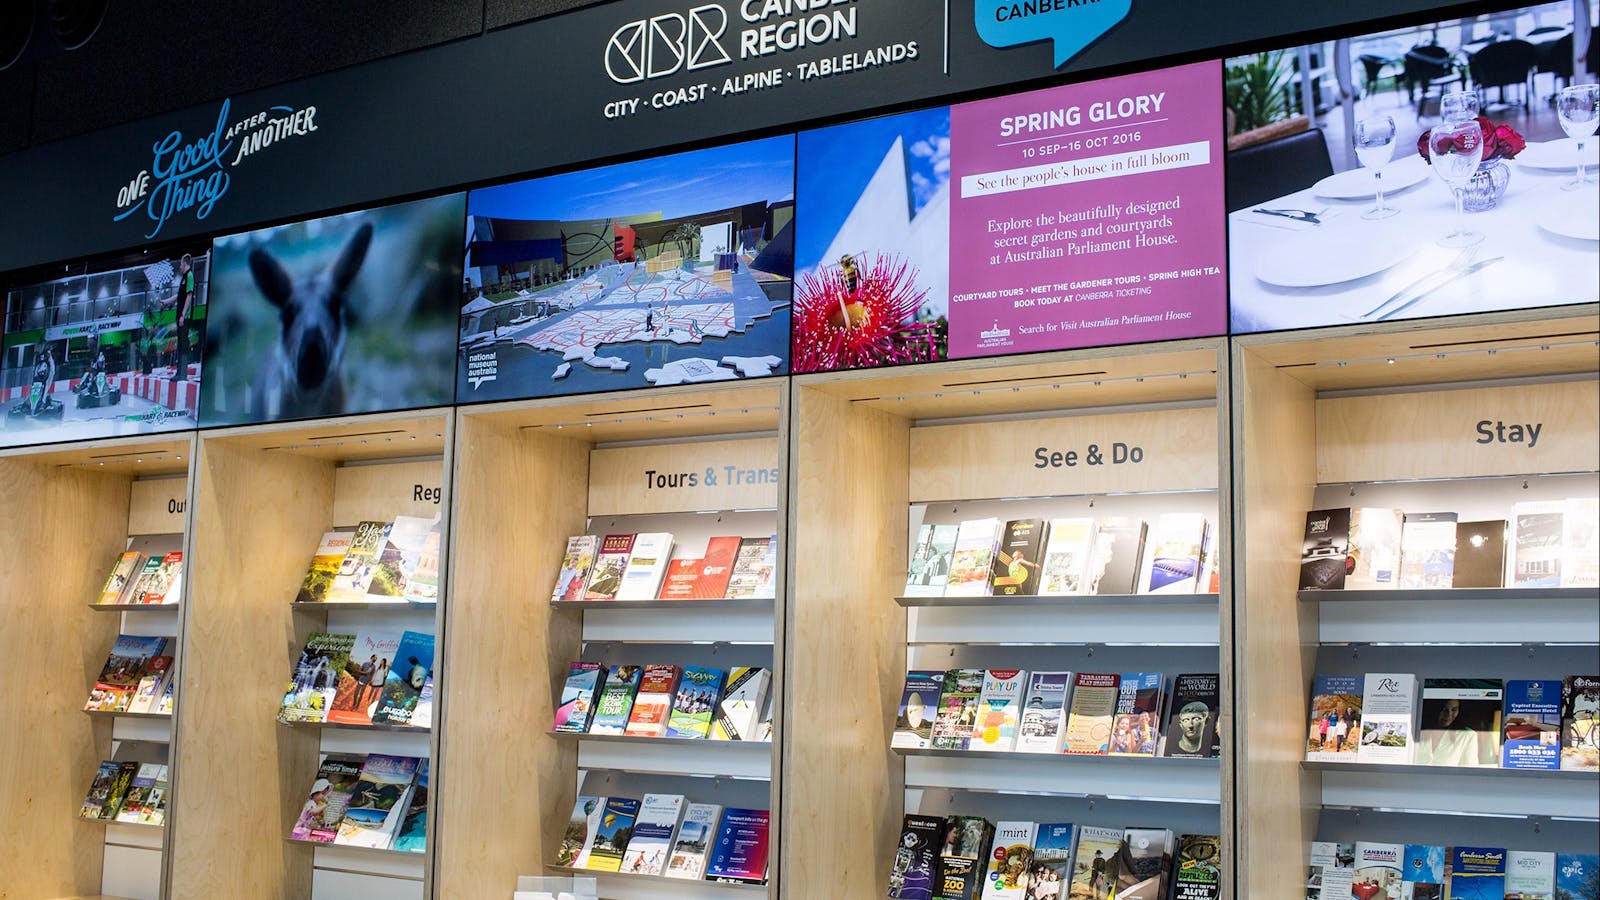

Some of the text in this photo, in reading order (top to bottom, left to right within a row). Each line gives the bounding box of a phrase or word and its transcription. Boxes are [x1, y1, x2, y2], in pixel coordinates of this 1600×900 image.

[740, 7, 857, 59] REGION
[604, 40, 919, 119] CITY COAST ALPINE TABLELANDS
[225, 111, 267, 140] AFTER
[1000, 92, 1166, 138] SPRING GLORY
[232, 106, 319, 166] ANOTHER
[1022, 147, 1035, 158] 10
[1086, 136, 1108, 149] OCT
[1113, 131, 1142, 146] 2016
[117, 97, 232, 239] ONE Good Thing
[977, 149, 1190, 191] See the people's house in full bloom
[987, 196, 1180, 234] Explore the beautifully designed
[994, 215, 1173, 249] secret gardens and courtyards
[990, 233, 1178, 265] at Australian Parliament House.
[953, 266, 1221, 303] COURTYARD TOURS MEET THE GARDENER TOURS SPRING HIGH TEA
[1014, 287, 1152, 308] BOOK TODAY AT CANBERRA TICKETING
[1018, 310, 1192, 335] Search for Visit Australian Parliament House
[468, 360, 497, 369] museum
[469, 352, 496, 362] national
[468, 367, 497, 376] australia
[1476, 420, 1543, 448] Stay
[1034, 442, 1144, 469] See & Do
[645, 466, 778, 489] Tours & Trans
[413, 484, 441, 504] Reg
[606, 692, 627, 700] BEST
[986, 682, 1018, 692] PLAY UP
[1121, 685, 1137, 695] OUR
[1186, 683, 1216, 691] WORLD
[602, 706, 622, 714] TOUR
[1117, 706, 1135, 714] ALIVE
[1118, 699, 1136, 707] COME
[1003, 829, 1027, 839] mint
[944, 880, 965, 890] ZOO
[1183, 888, 1209, 896] ALIVE
